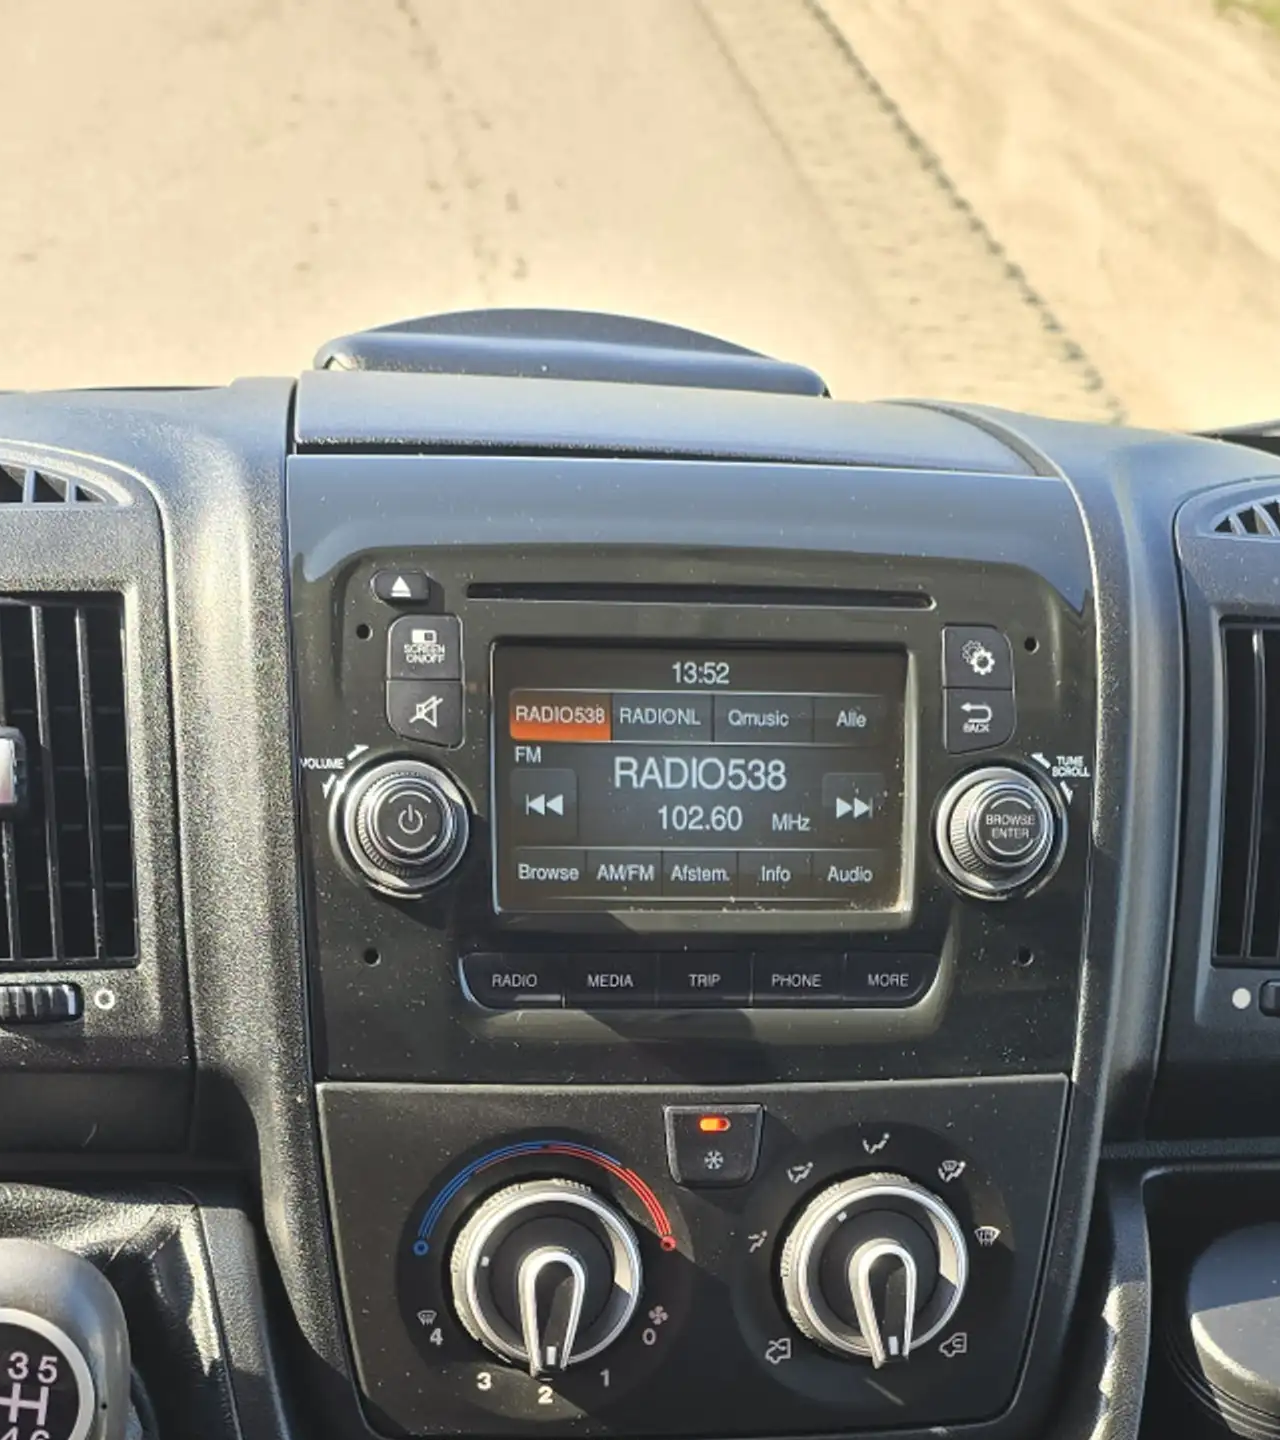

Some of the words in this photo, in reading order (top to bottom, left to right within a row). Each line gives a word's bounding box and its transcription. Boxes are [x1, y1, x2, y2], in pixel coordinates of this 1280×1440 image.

[404, 644, 446, 654] SCREEN
[406, 653, 446, 664] ON/OFF
[671, 661, 730, 685] 13:52
[515, 704, 605, 724] RADIO538
[620, 706, 701, 727] RADIONL
[728, 709, 790, 729] Qmusic
[836, 710, 867, 728] Alle
[963, 723, 990, 733] BACK
[300, 757, 345, 770] VOLUME
[515, 747, 542, 764] FM
[613, 756, 788, 791] RADIO538
[1052, 766, 1090, 778] SCROLL
[658, 805, 743, 832] 102.60
[772, 812, 811, 832] MHz
[986, 813, 1036, 826] BROWSE
[992, 826, 1030, 839] ENTER
[518, 863, 580, 882] Browse
[596, 864, 655, 882] AM/FM
[670, 864, 730, 882] Afstem.
[762, 864, 792, 883] Info
[827, 865, 873, 882] Audio
[491, 973, 538, 988] RADIO
[587, 973, 634, 988] MEDIA
[688, 973, 721, 988] TRIP
[771, 973, 822, 988] PHONE
[867, 973, 909, 988] MORE
[429, 1328, 443, 1346] 4
[642, 1328, 656, 1346] 0
[7, 1352, 29, 1380] 3
[37, 1356, 58, 1384] 5
[476, 1371, 492, 1390] 3
[600, 1368, 610, 1388] 1
[537, 1385, 553, 1405] 2
